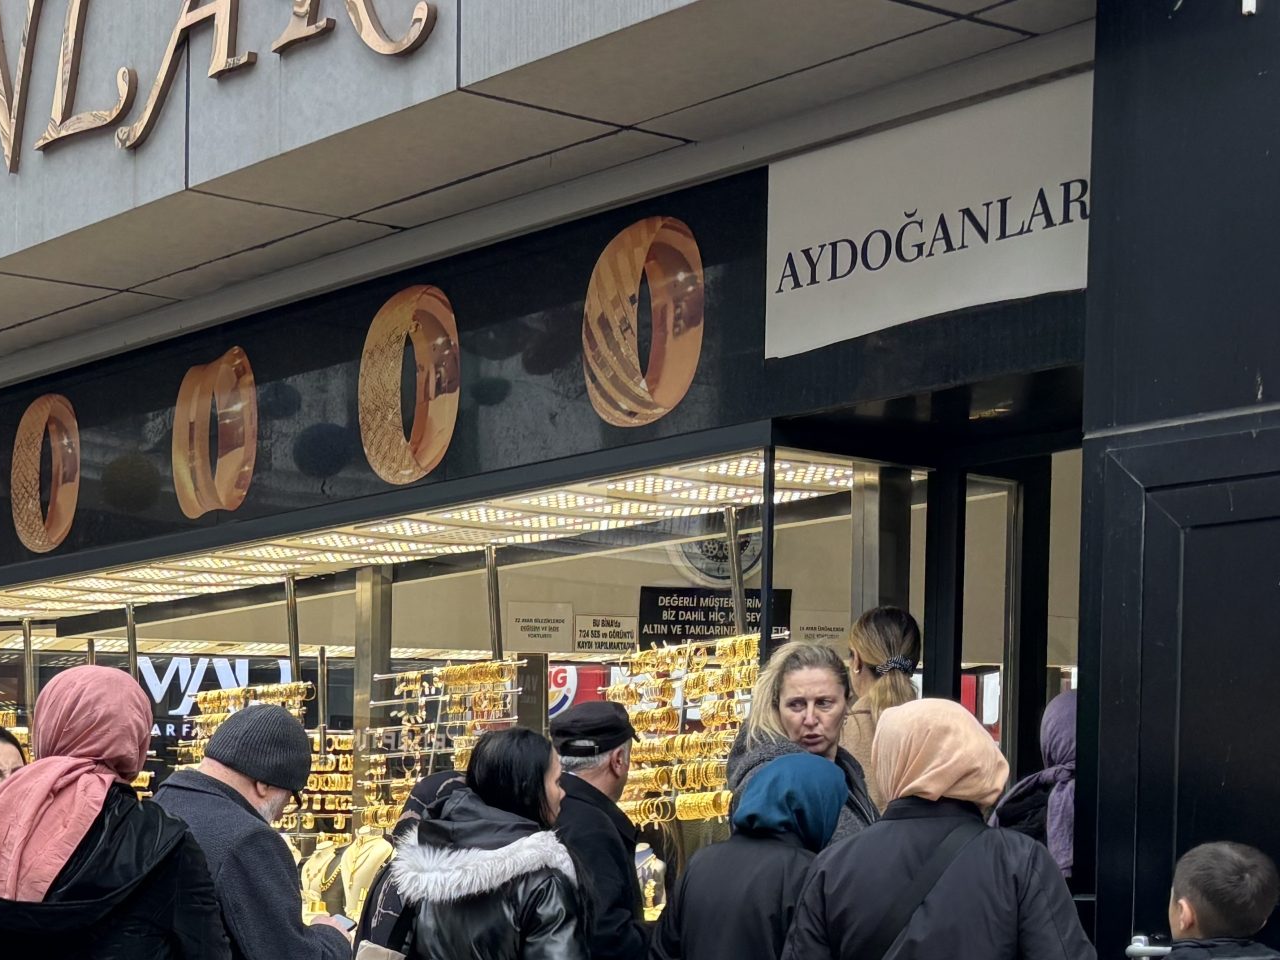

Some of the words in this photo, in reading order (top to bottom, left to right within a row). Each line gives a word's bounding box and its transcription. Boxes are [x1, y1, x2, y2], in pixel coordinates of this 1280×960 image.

[775, 177, 1091, 294] AYDOĞANLAR
[658, 593, 697, 607] DEĞERLİ
[662, 609, 675, 621] BİZ
[678, 609, 706, 622] DAHİL
[708, 610, 725, 623] HİÇ
[592, 618, 600, 628] BU
[591, 629, 600, 639] SES
[609, 627, 635, 639] GÖRÜNTÜ
[642, 625, 668, 635] ALTIN
[671, 625, 682, 635] VE
[577, 640, 593, 649] KAYDI
